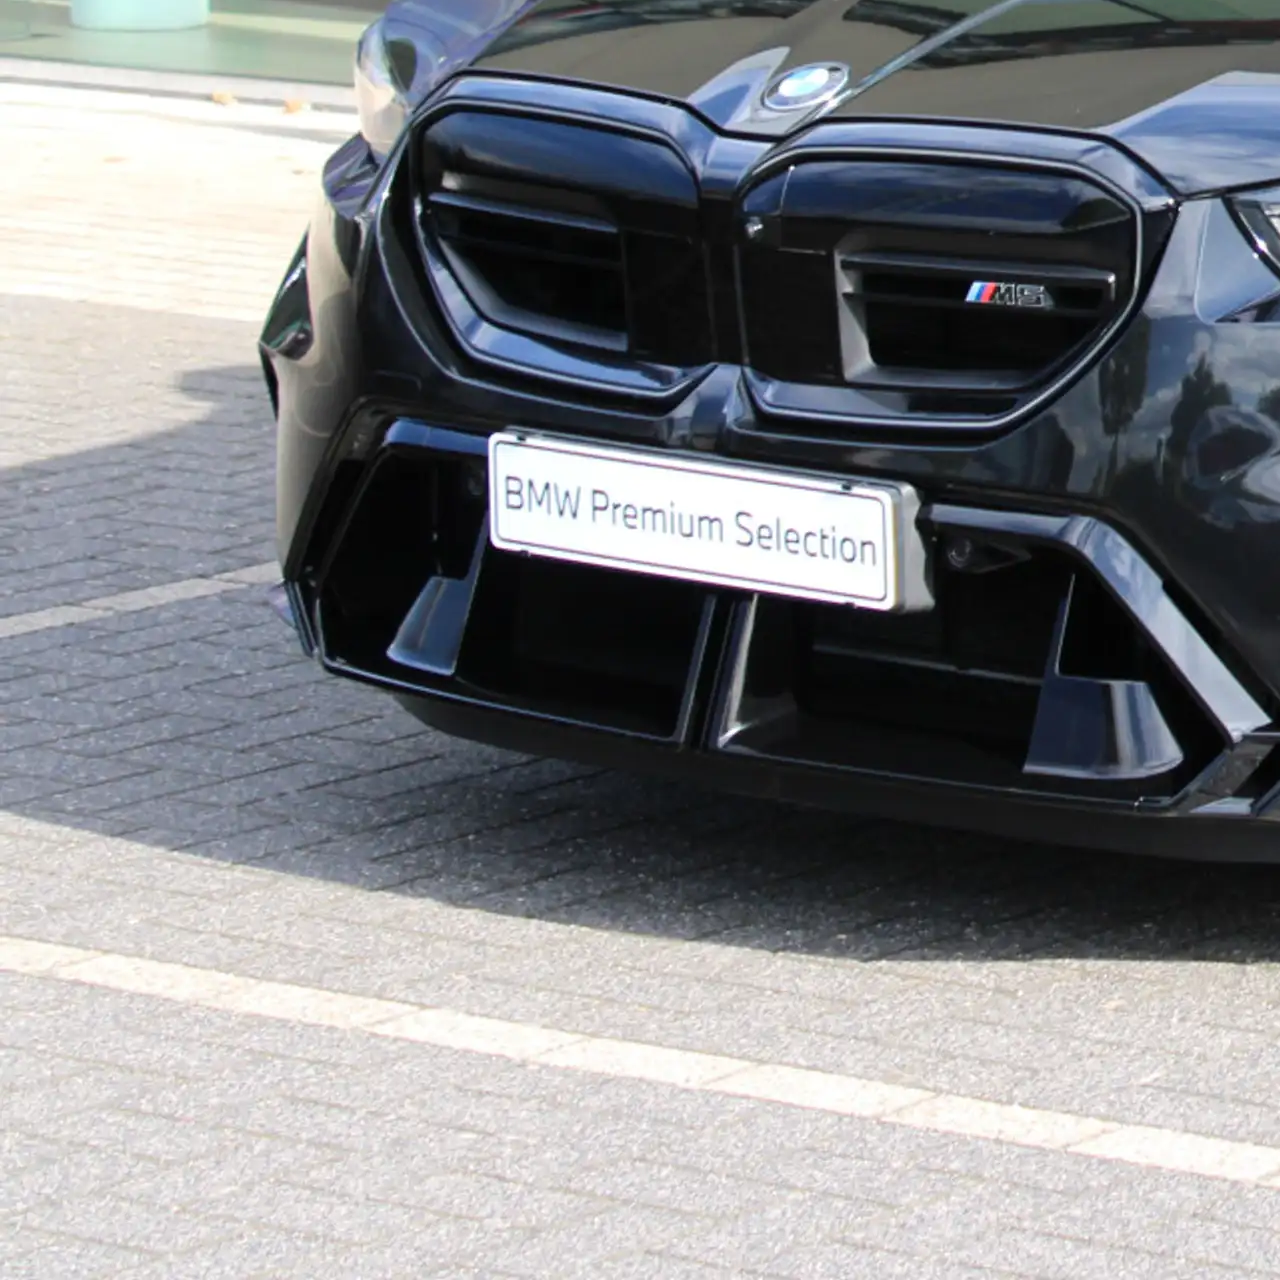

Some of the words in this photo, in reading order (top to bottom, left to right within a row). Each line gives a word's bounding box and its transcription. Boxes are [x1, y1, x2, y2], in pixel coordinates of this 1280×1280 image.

[990, 281, 1046, 308] M5
[503, 475, 582, 520] BMW
[591, 488, 725, 544] Premium
[734, 510, 878, 567] Selection
